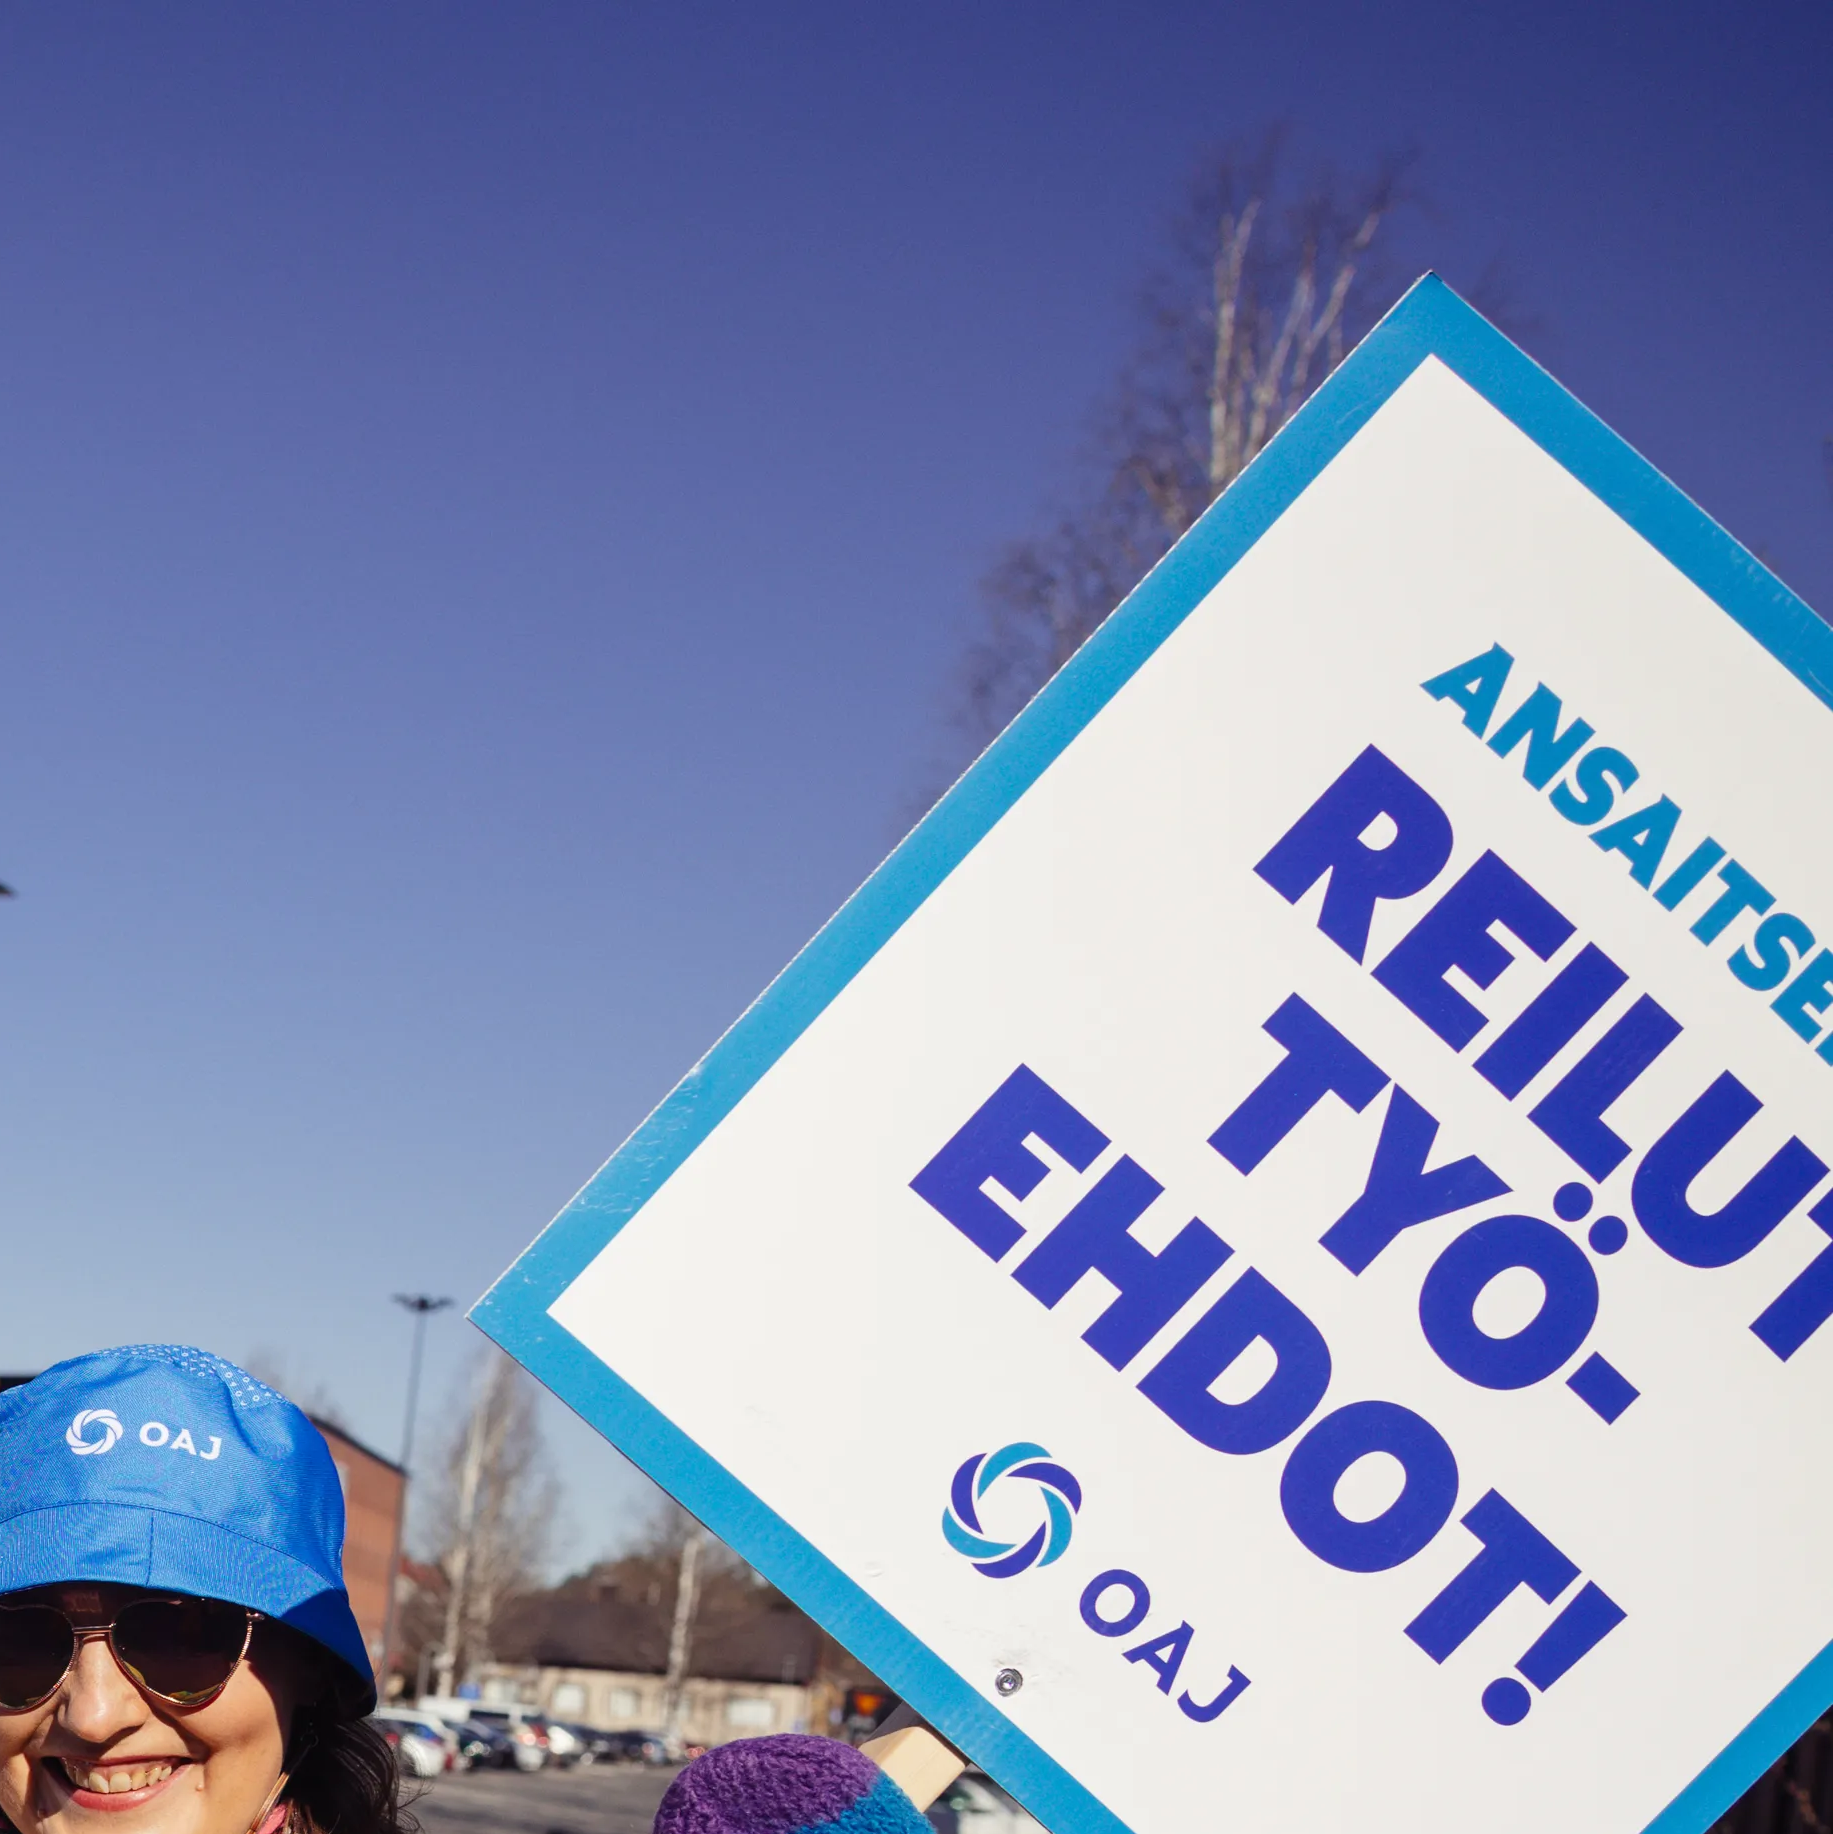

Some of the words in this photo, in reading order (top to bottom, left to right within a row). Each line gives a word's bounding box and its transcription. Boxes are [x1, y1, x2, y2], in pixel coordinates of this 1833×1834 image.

[1421, 641, 1833, 1067] ANSAITSE
[908, 1062, 1627, 1726] EHDOT!
[1207, 991, 1640, 1424] TYÖ-
[139, 1421, 222, 1460] OAJ
[1078, 1568, 1251, 1723] OAJ
